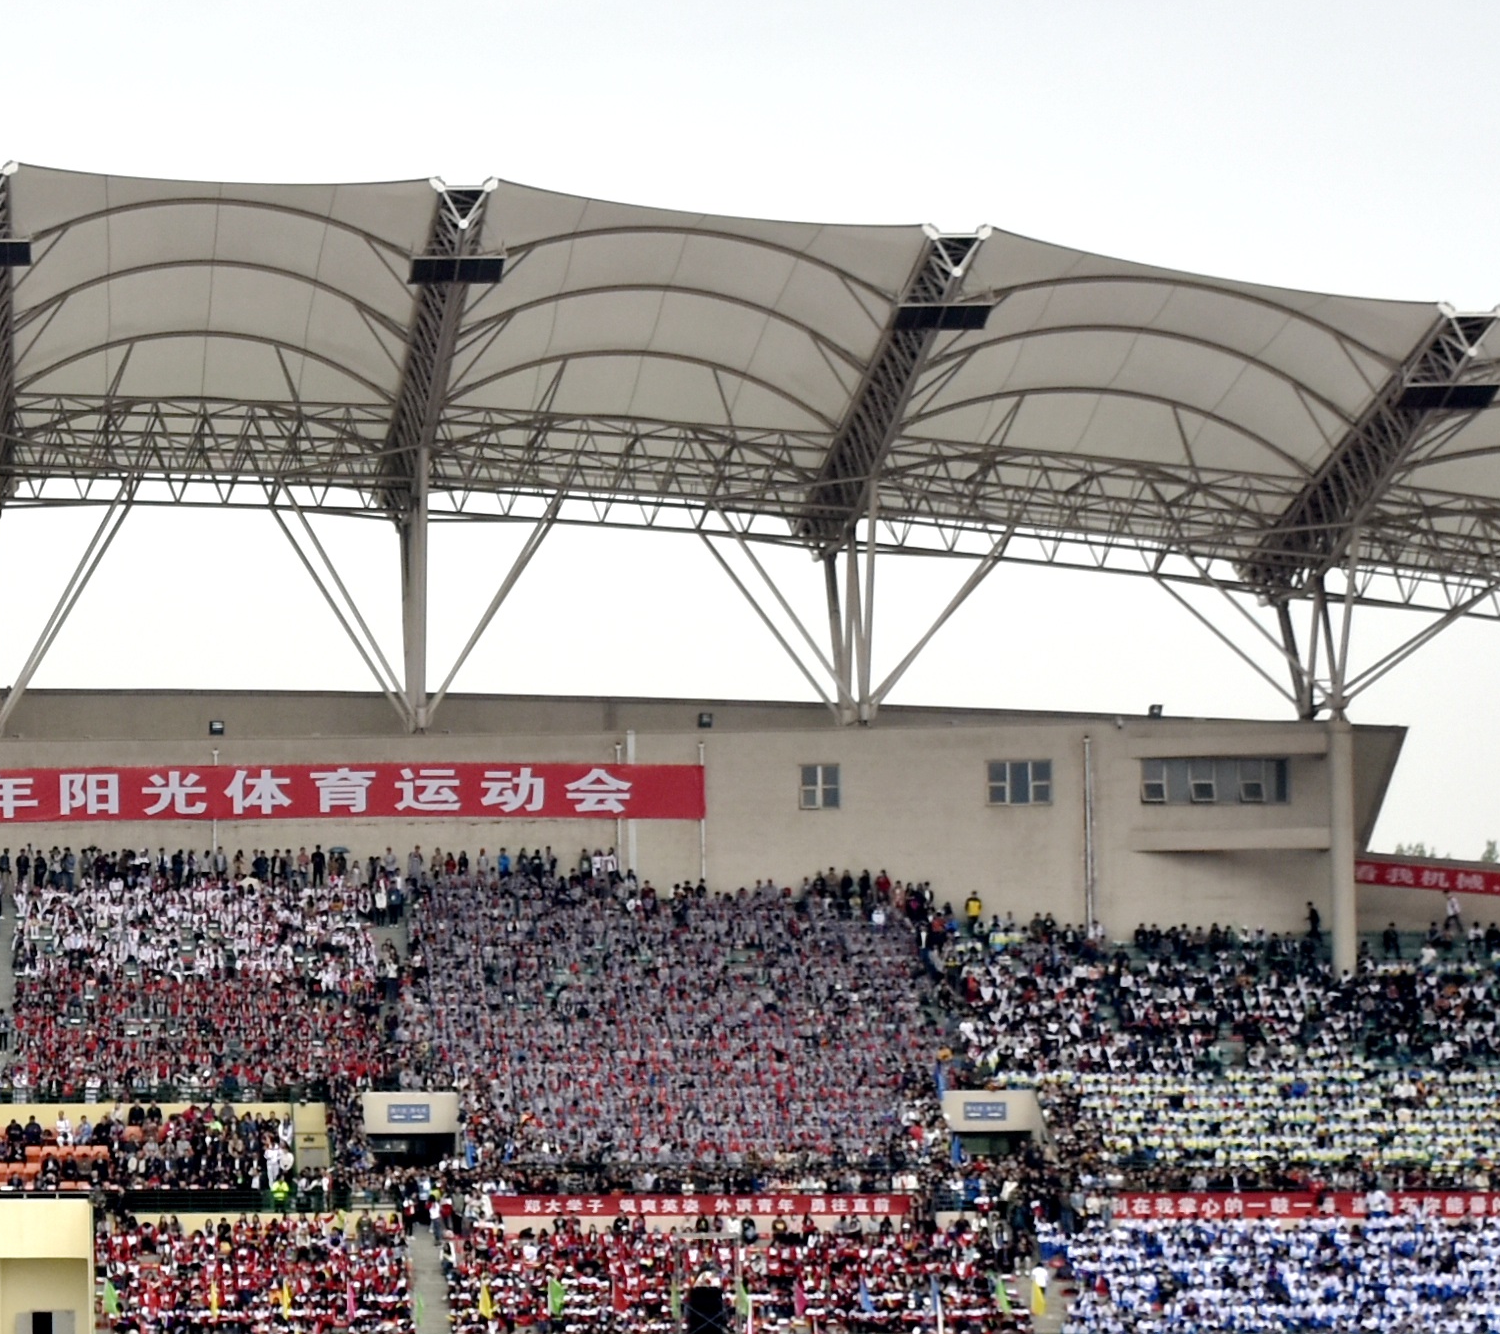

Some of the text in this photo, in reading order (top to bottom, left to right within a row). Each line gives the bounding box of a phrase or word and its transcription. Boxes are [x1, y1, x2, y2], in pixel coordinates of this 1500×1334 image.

[524, 1198, 604, 1214] 郑大学子
[714, 1198, 795, 1214] 外语青年
[811, 1198, 891, 1214] 勇往直前
